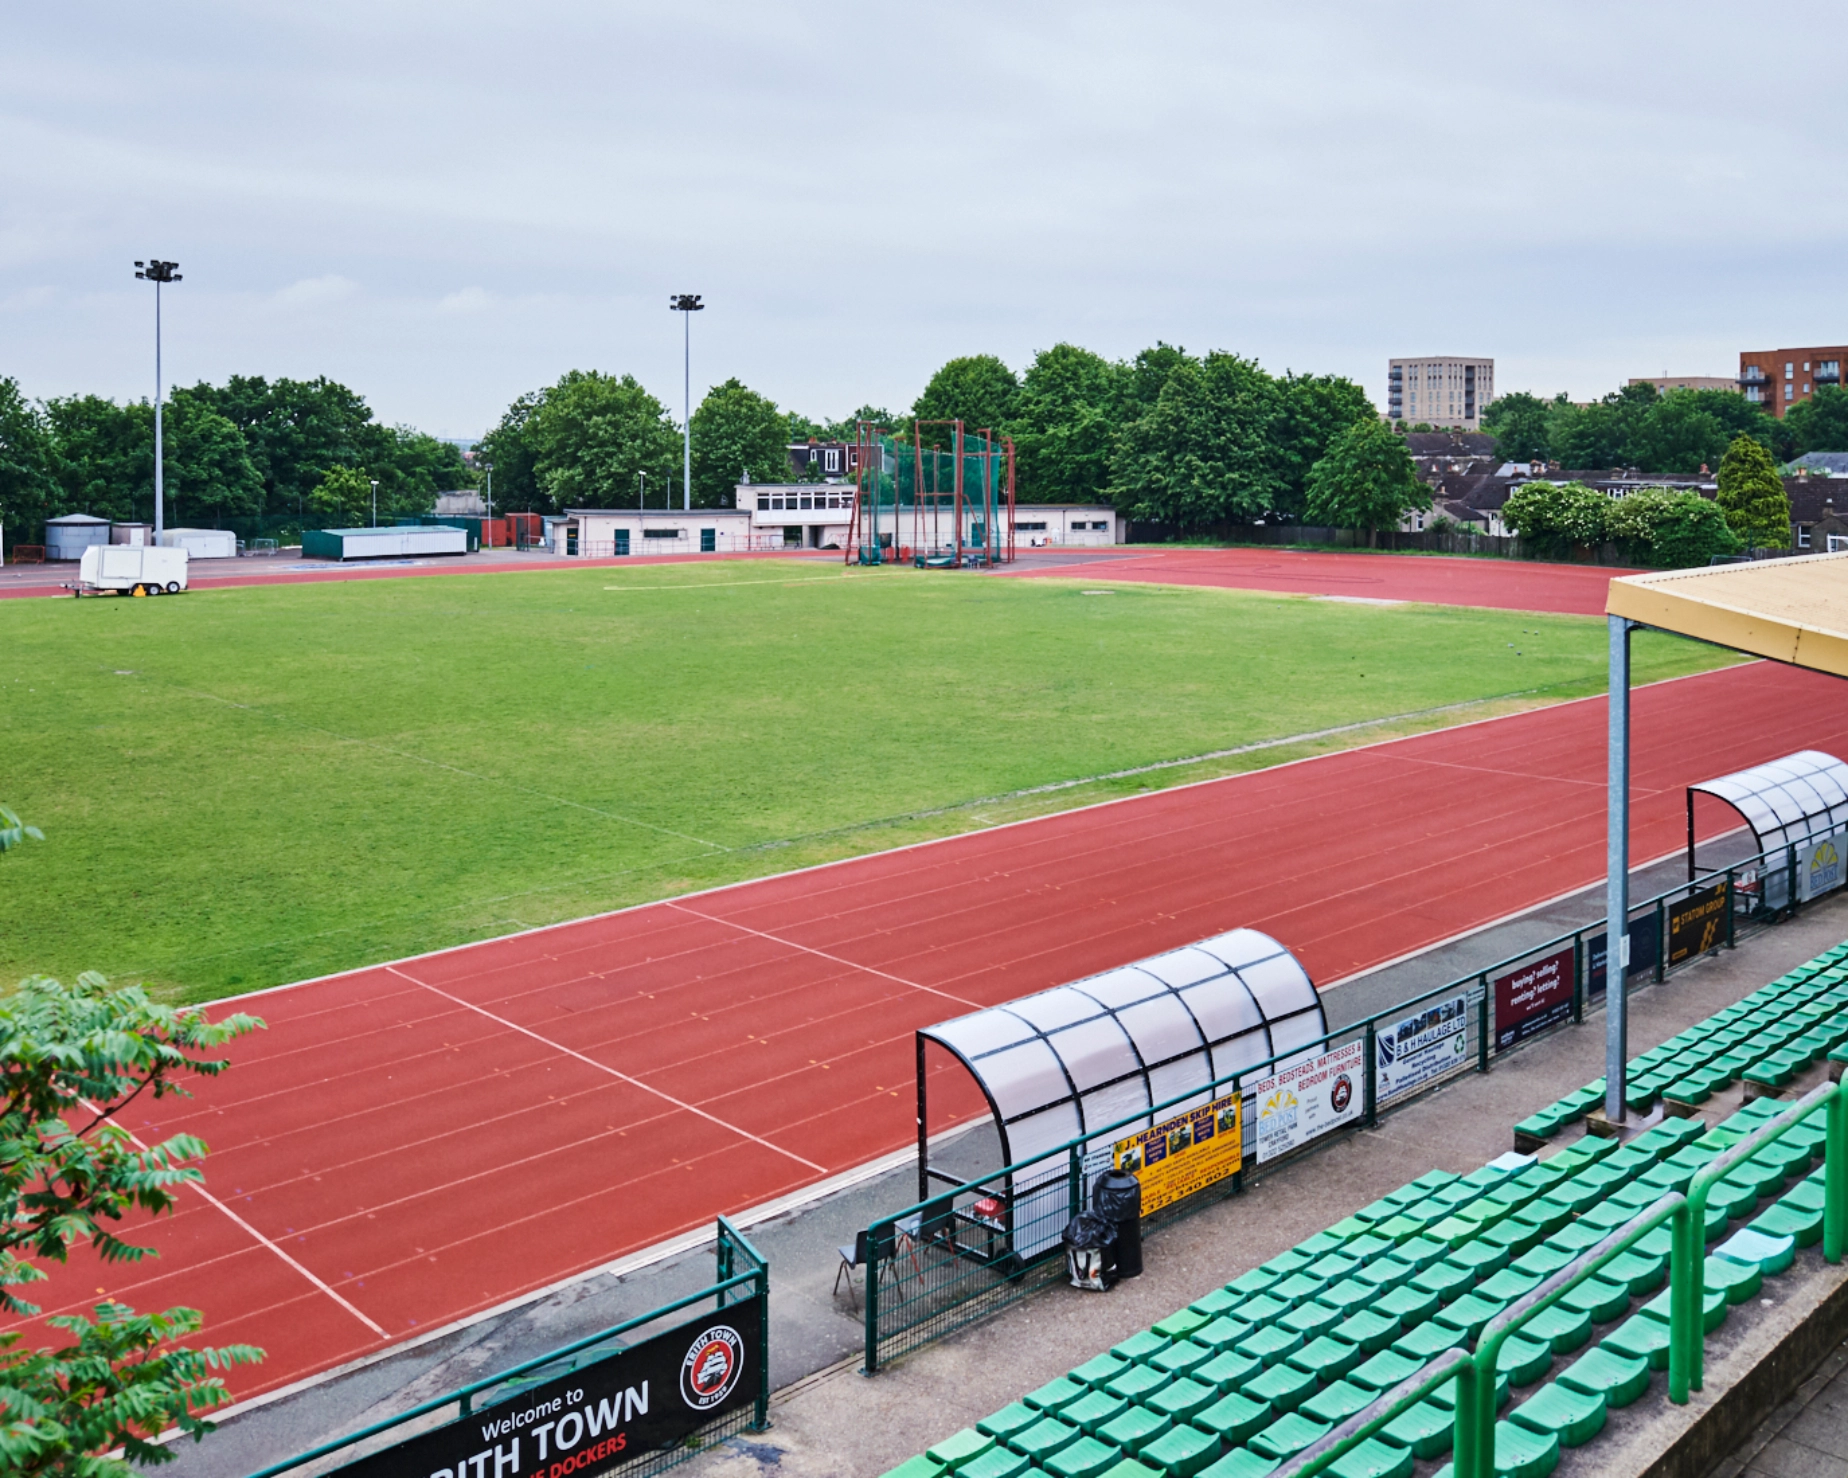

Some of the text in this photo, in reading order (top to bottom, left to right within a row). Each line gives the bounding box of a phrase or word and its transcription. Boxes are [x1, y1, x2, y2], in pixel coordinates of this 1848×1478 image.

[1706, 896, 1726, 914] GROUP
[1511, 975, 1560, 1006] renting? letting?
[1512, 960, 1559, 990] buying? selling?
[1397, 1016, 1465, 1056] B & H HAULAGE LTD
[1258, 1077, 1276, 1094] BEDS,
[1279, 1061, 1316, 1086] BEDSTEADS,
[1318, 1044, 1355, 1068] MATTRESSES
[1357, 1042, 1361, 1051] &
[1298, 1070, 1327, 1092] BEDROOM
[1330, 1055, 1361, 1078] FURNITURE
[1137, 1116, 1188, 1145] HEARNDEN
[1191, 1106, 1210, 1122] SKIP
[1213, 1097, 1232, 1112] HIRE
[1259, 1116, 1275, 1136] BED
[710, 1329, 738, 1347] TOWN
[481, 1388, 584, 1442] Welcome to
[531, 1380, 649, 1461] TOWN
[550, 1432, 627, 1478] DOCKERS
